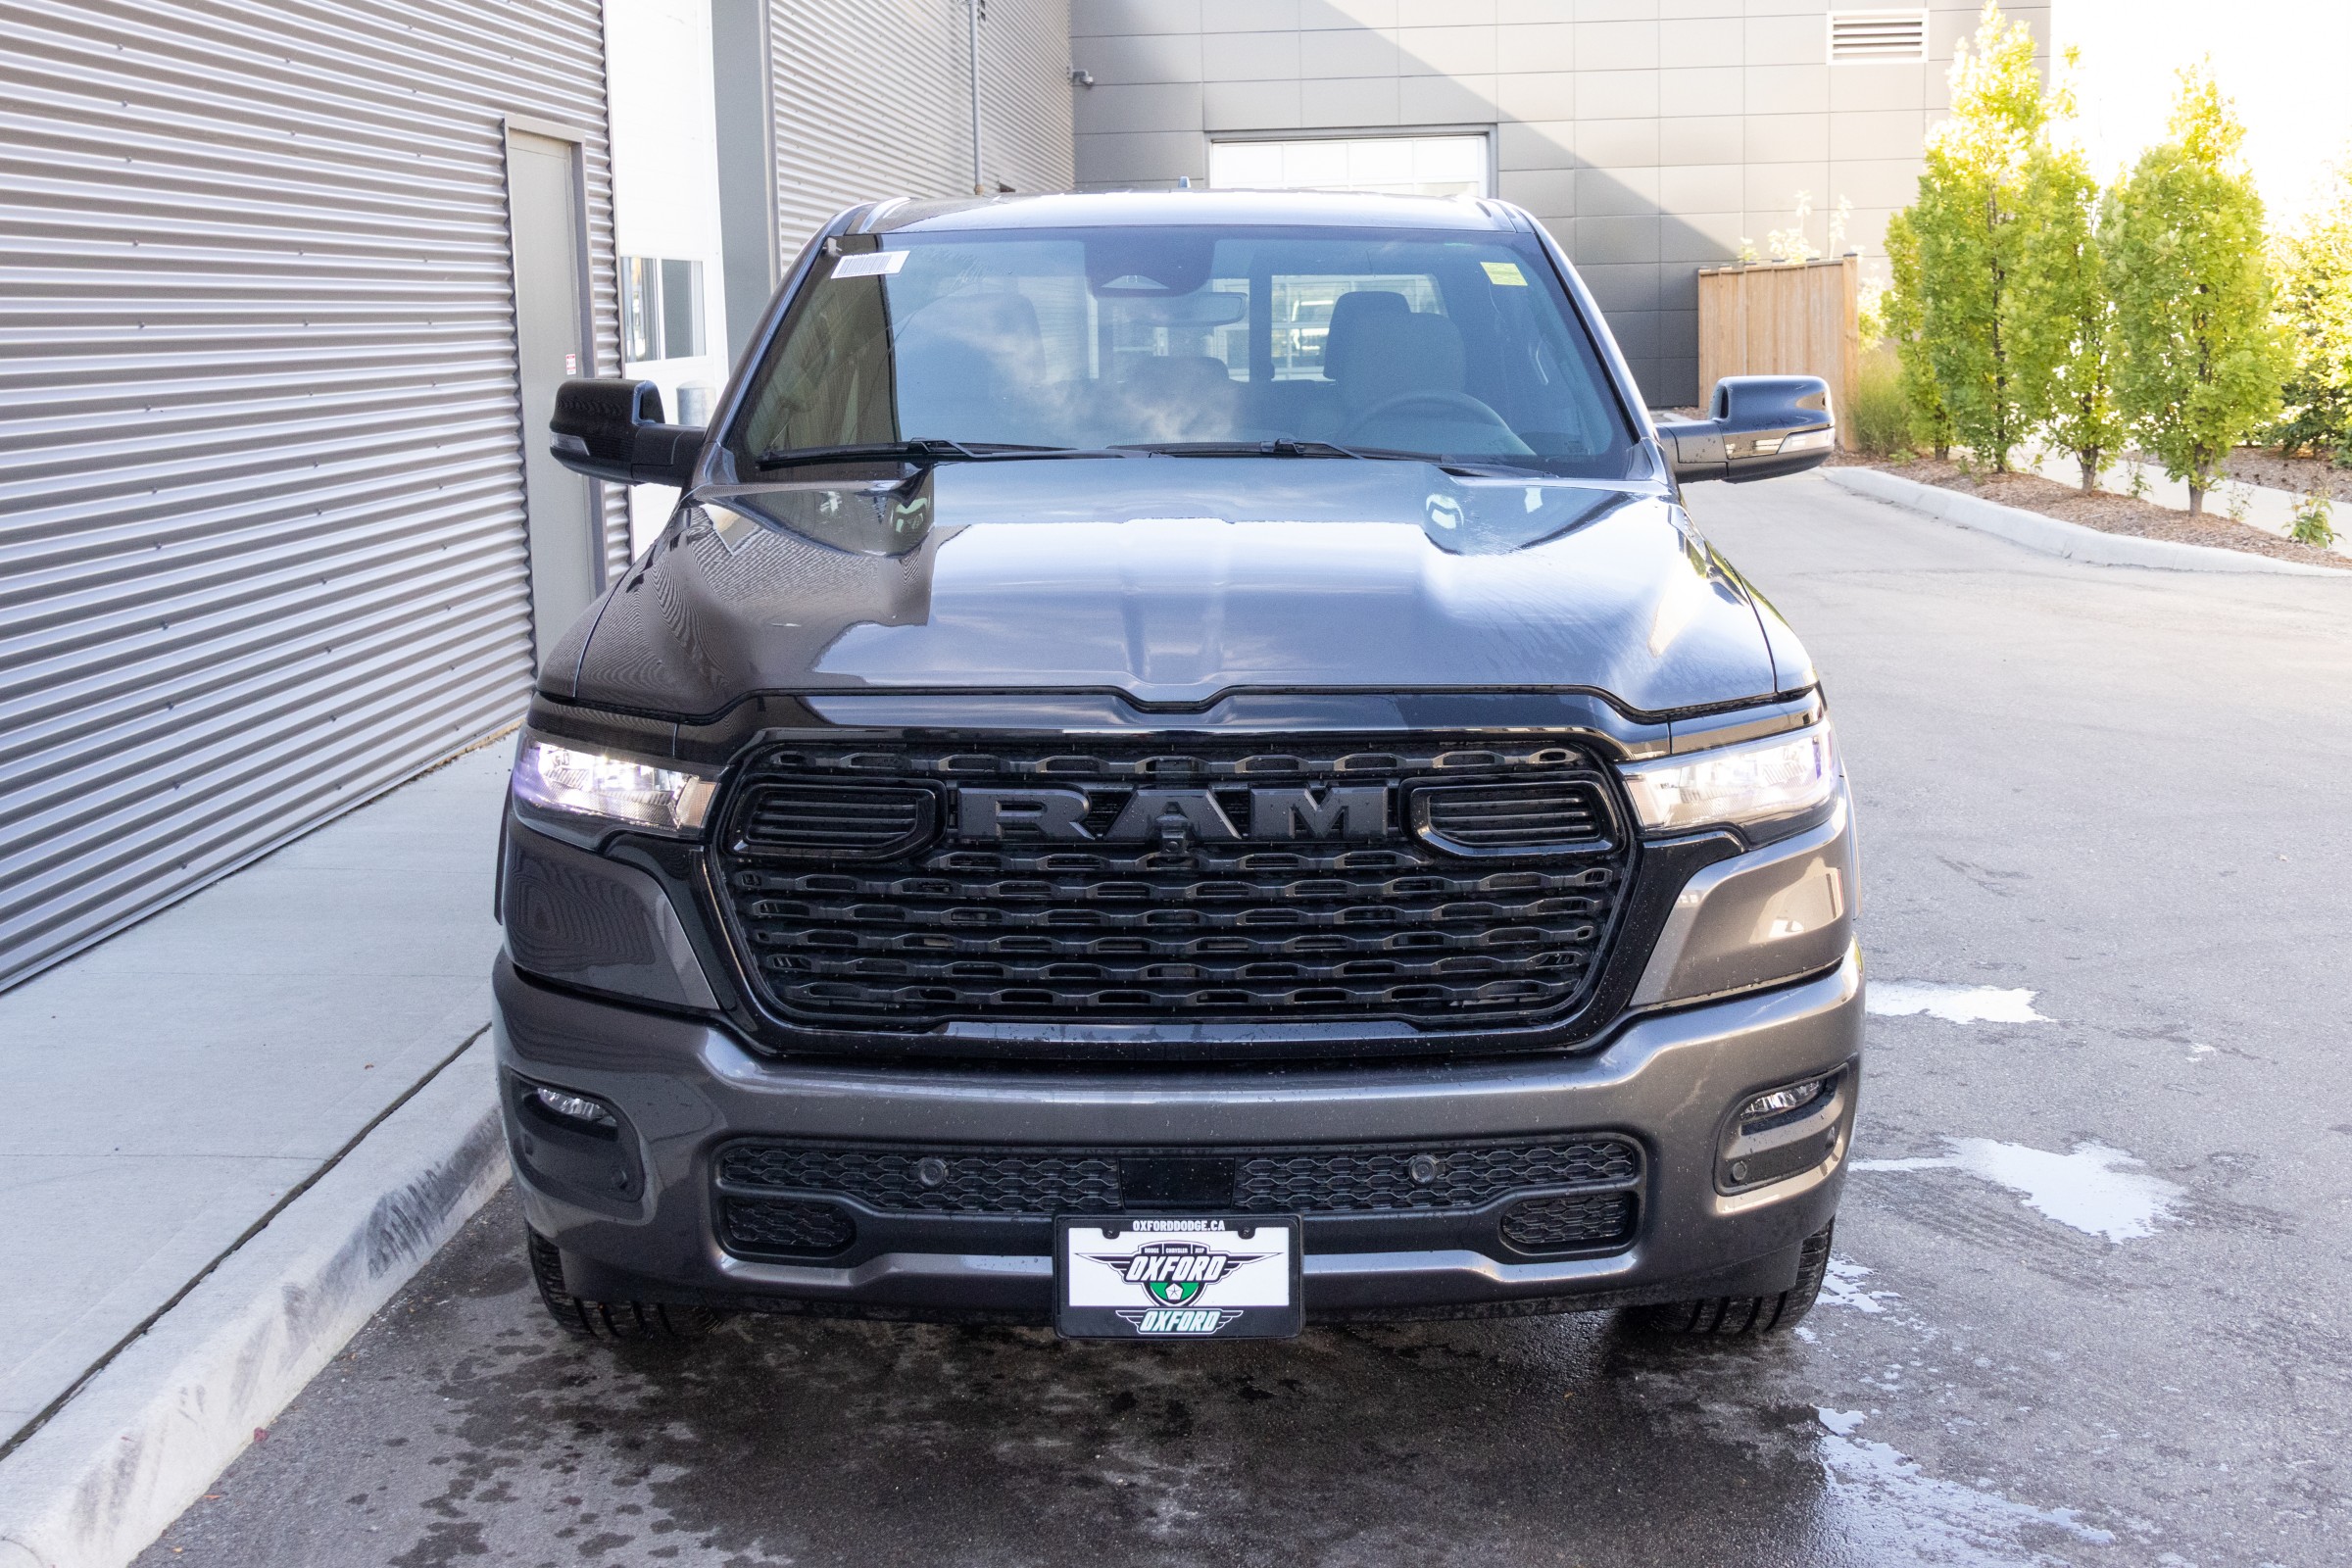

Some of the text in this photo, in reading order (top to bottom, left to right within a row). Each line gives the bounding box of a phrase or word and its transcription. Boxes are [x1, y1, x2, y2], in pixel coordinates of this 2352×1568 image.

[957, 787, 1389, 841] RAM
[1133, 1220, 1225, 1231] OXFORDDODGE.CA
[1126, 1256, 1227, 1281] OXFORD
[1140, 1311, 1221, 1332] OXFORD
